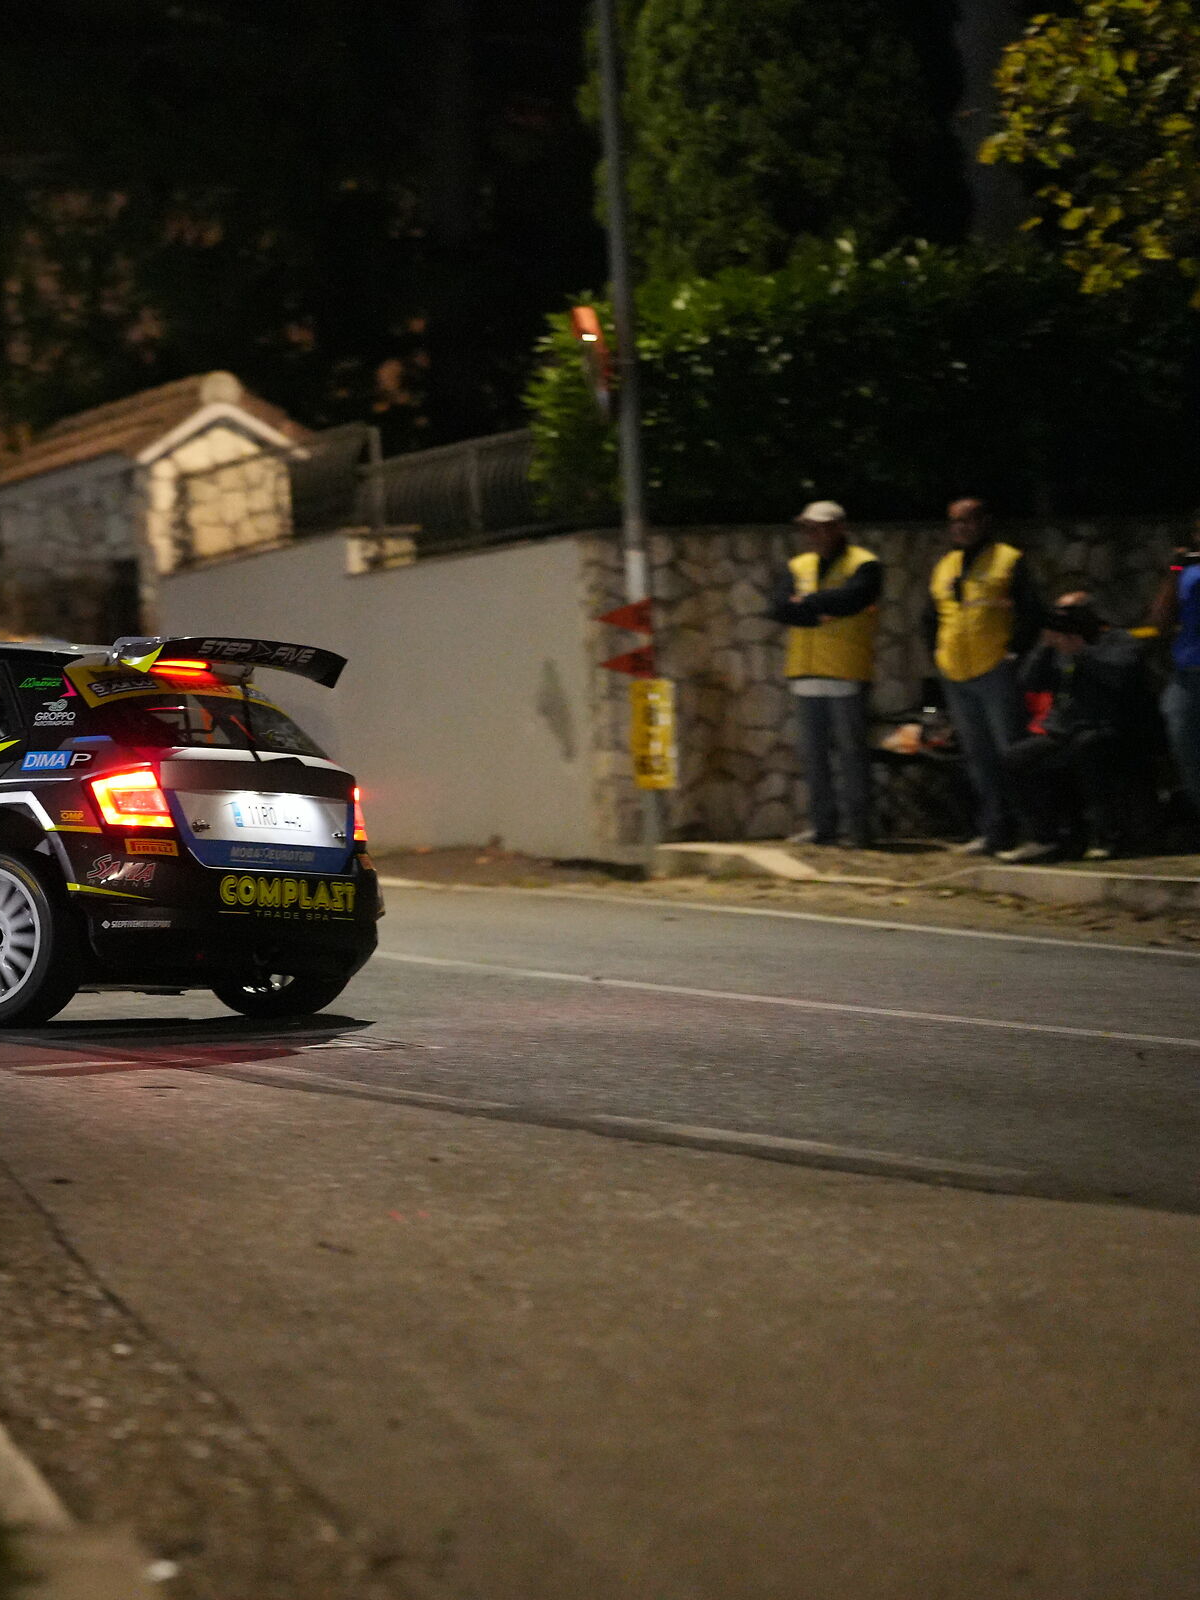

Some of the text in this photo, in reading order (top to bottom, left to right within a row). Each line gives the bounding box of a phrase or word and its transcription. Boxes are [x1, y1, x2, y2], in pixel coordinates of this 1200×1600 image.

[198, 640, 317, 664] STEP FIVE
[34, 711, 76, 721] GROPPO
[23, 753, 92, 768] DIMA P
[60, 812, 84, 820] OMP
[129, 840, 174, 854] PIRELLI
[87, 878, 152, 888] RCING
[220, 874, 356, 912] COMPLAST
[255, 910, 329, 921] TRADE SPA
